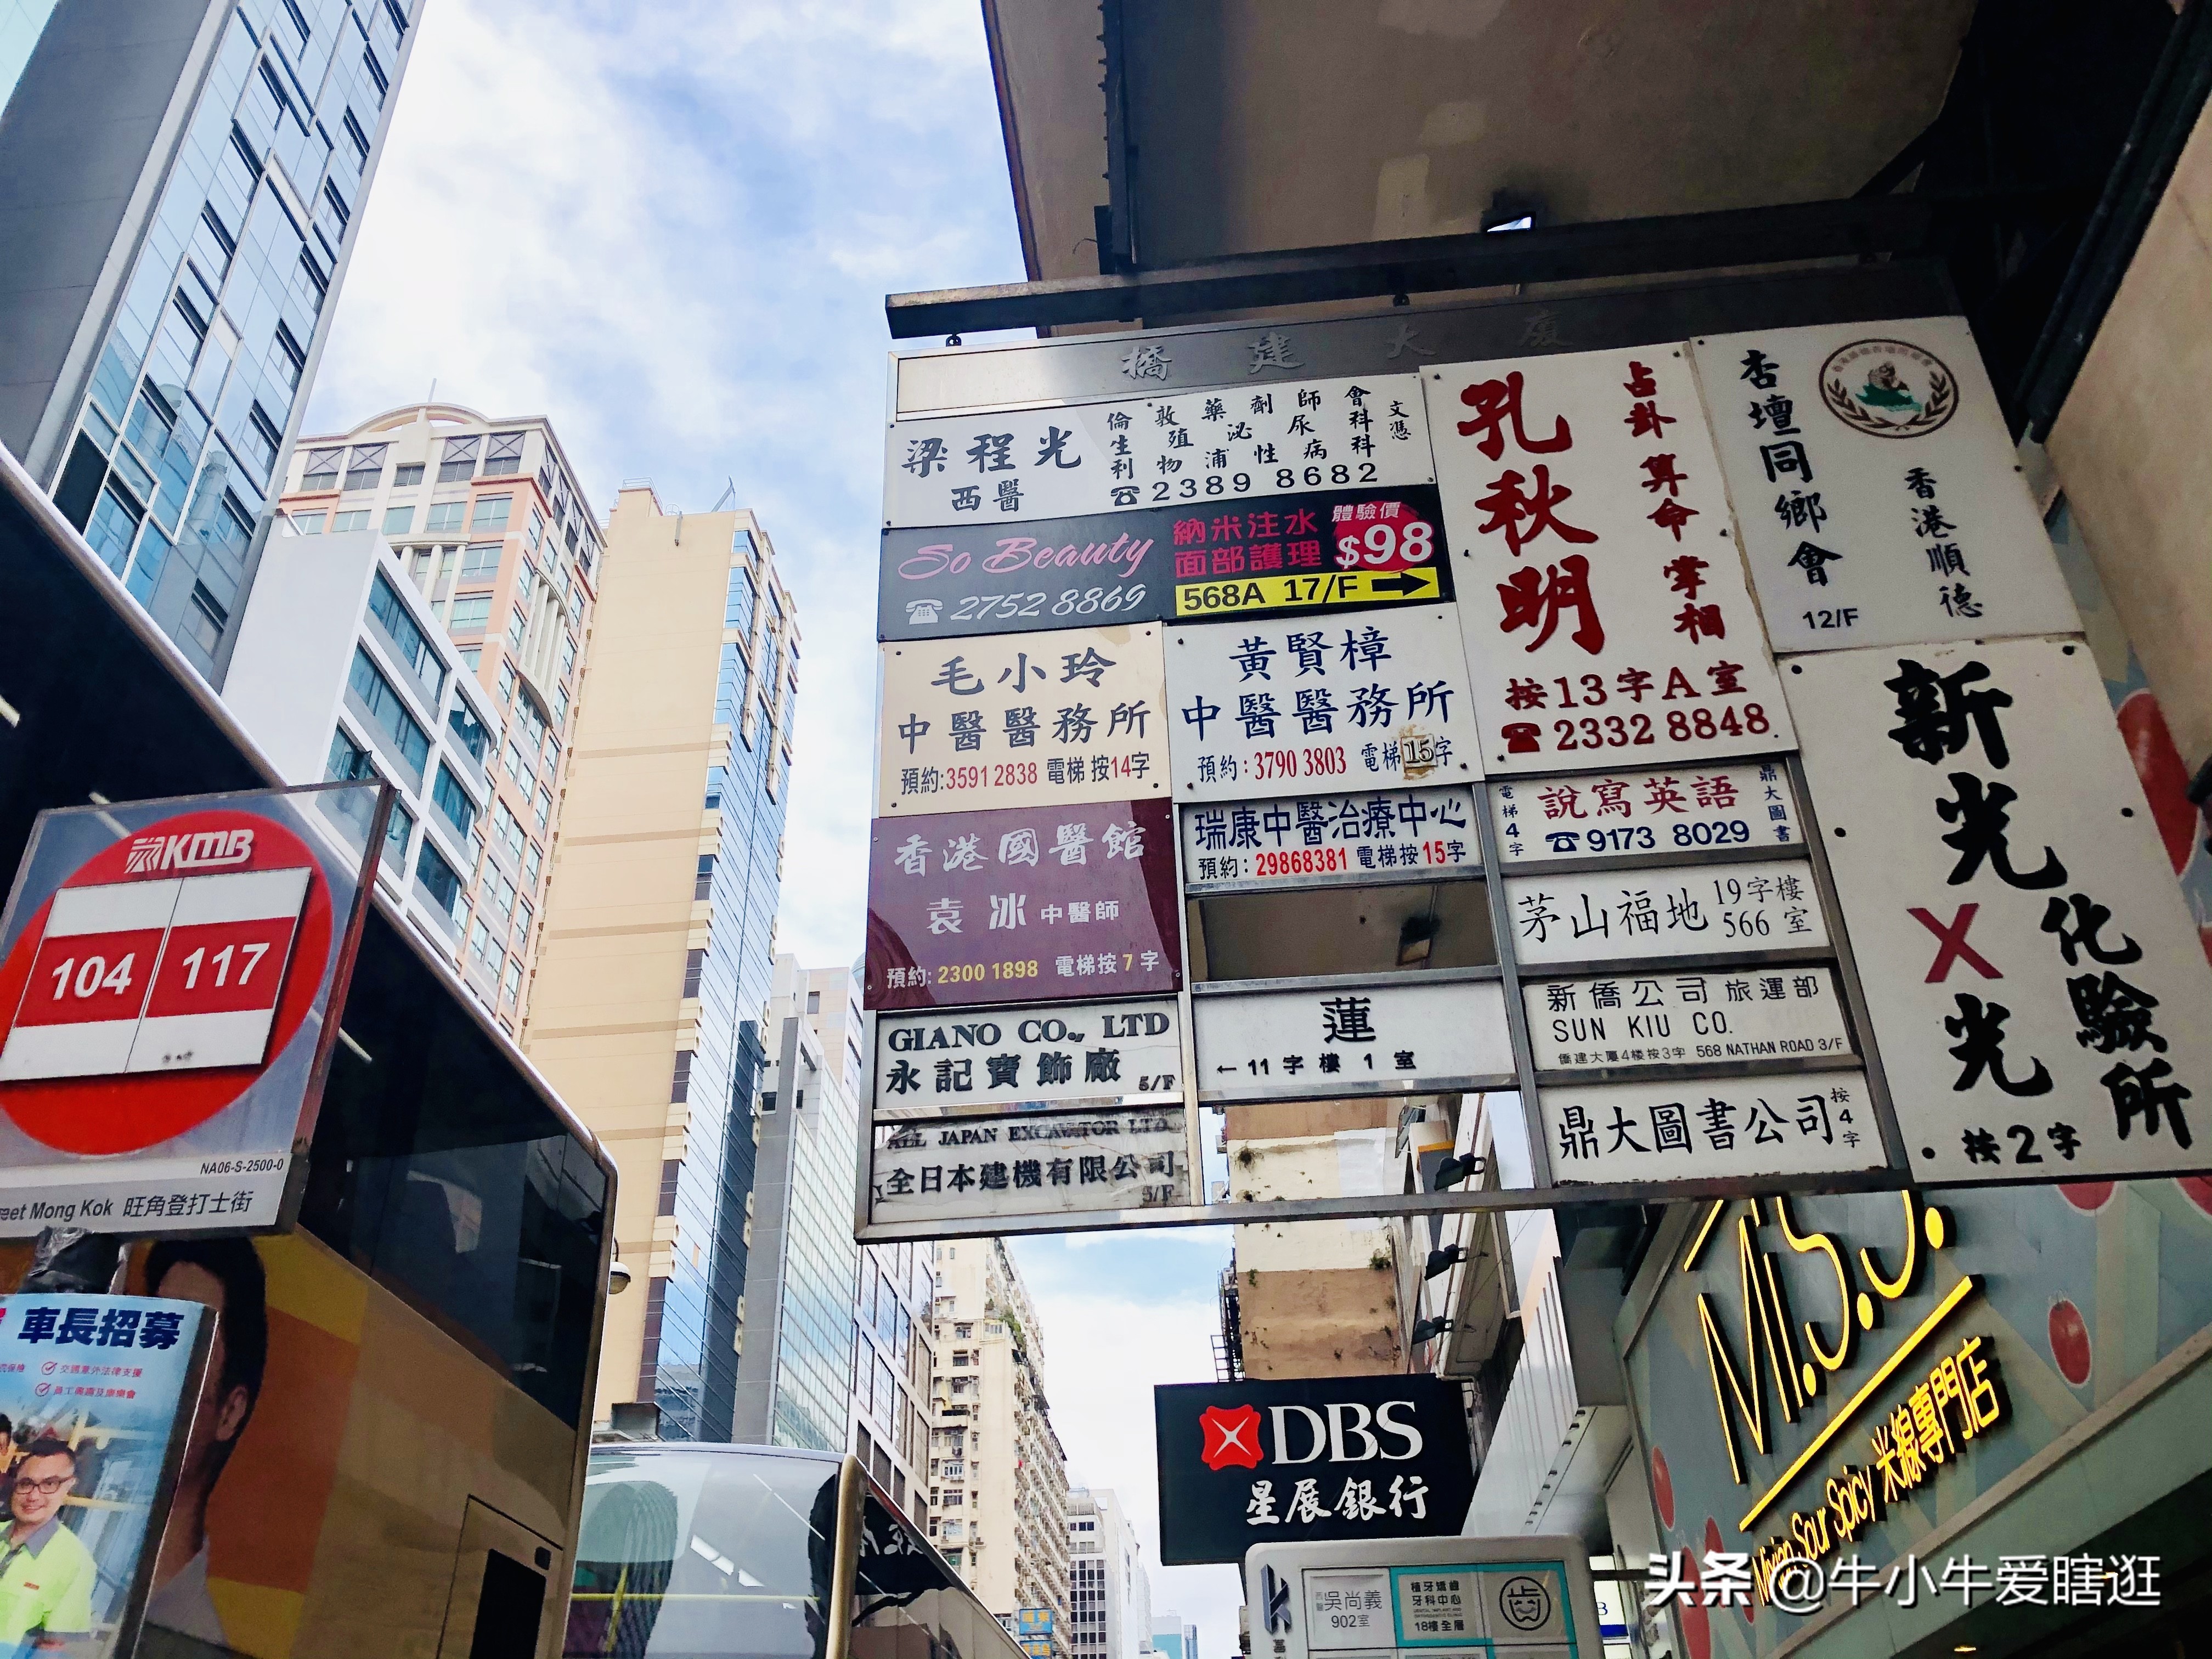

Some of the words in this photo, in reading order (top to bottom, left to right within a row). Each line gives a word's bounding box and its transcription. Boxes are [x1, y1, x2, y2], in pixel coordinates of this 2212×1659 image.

[1389, 400, 1411, 441] 文憑
[901, 426, 1081, 477] 梁程光
[1740, 349, 1843, 586] 杏壇同鄉會
[951, 479, 1024, 512] 西醫
[1152, 472, 1251, 501] 2389
[1276, 462, 1378, 488] 8682
[1173, 508, 1318, 545] 納米注水
[1331, 501, 1402, 523] 體驗價
[1457, 371, 1605, 655] 孔秋明
[898, 544, 972, 580] So
[982, 533, 1154, 578] Beauty
[1174, 540, 1322, 578] 面部護理
[1336, 522, 1434, 570] $98
[1905, 466, 1983, 618] 香港順德
[950, 591, 1047, 622] 2752
[1051, 584, 1146, 616] 8869
[1184, 582, 1267, 611] 568A
[1284, 574, 1359, 603] 17/F
[1803, 608, 1859, 629] 12/F
[931, 647, 1117, 696] 毛小玲
[1229, 626, 1392, 682] 黃賢樟
[1505, 660, 1747, 710] 按13字A室
[898, 700, 1151, 755] 中醫醫務所
[1181, 680, 1454, 742] 中醫醫務所
[1554, 714, 1655, 751] 2332
[1667, 703, 1769, 742] 8848
[1303, 746, 1346, 776] 3803
[1537, 775, 1739, 820] 說寫英語
[1759, 764, 1791, 842] 鼎大圖書
[1195, 793, 1466, 851] 瑞康中醫治療中心
[1498, 785, 1524, 856] 電梯4字
[1587, 827, 1656, 851] 9173
[1674, 820, 1750, 847] 8029
[162, 829, 255, 870] KMB
[894, 821, 1146, 877] 香港國醫館
[1713, 874, 1804, 906] 19字樓
[1040, 900, 1119, 926] 中醫師
[1517, 887, 1709, 943] 茅山福地
[1723, 906, 1812, 939] 566室
[50, 952, 136, 1001] 104
[182, 943, 270, 989] 117
[992, 960, 1039, 979] 1898
[888, 1023, 1001, 1052] GIANO
[1102, 1012, 1170, 1039] LTD
[1319, 996, 1376, 1043] 蓮
[1553, 1018, 1605, 1043] SUN
[1629, 1014, 1671, 1039] KIU
[1692, 1011, 1733, 1035] CO.
[2039, 893, 2192, 1149] 化驗所
[1696, 1045, 1722, 1058] 568
[1726, 1041, 1776, 1056] NATHAN
[1780, 1040, 1814, 1053] ROAD
[1818, 1037, 1842, 1051] 3/F
[885, 1047, 1121, 1094] 永記寶飾廠
[1138, 1074, 1176, 1091] 5/F
[939, 1128, 998, 1146] JAPAN
[1008, 1120, 1120, 1141] EXCAVATOR
[1559, 1094, 1834, 1160] 鼎大圖書公司
[1830, 1088, 1860, 1148] 按4字
[1961, 1121, 2081, 1166] 按2字
[200, 1158, 284, 1175] NA06-S-2500-0
[886, 1150, 1174, 1195] 全日本建機有限公司
[29, 1201, 76, 1222] Mong
[80, 1198, 114, 1216] Kok
[122, 1189, 255, 1217] 旺角登打士街
[17, 1306, 184, 1350] 車長招募
[1268, 1401, 1423, 1465] DBS
[1871, 1336, 2000, 1502] 米線專門店
[1246, 1475, 1429, 1526] 星展銀行
[1792, 1512, 1830, 1568] Sour
[1826, 1465, 1876, 1543] Spicy
[1324, 1590, 1383, 1611] 吳尚義
[1331, 1615, 1370, 1628] 902室
[1412, 1594, 1462, 1606] 牙科中心
